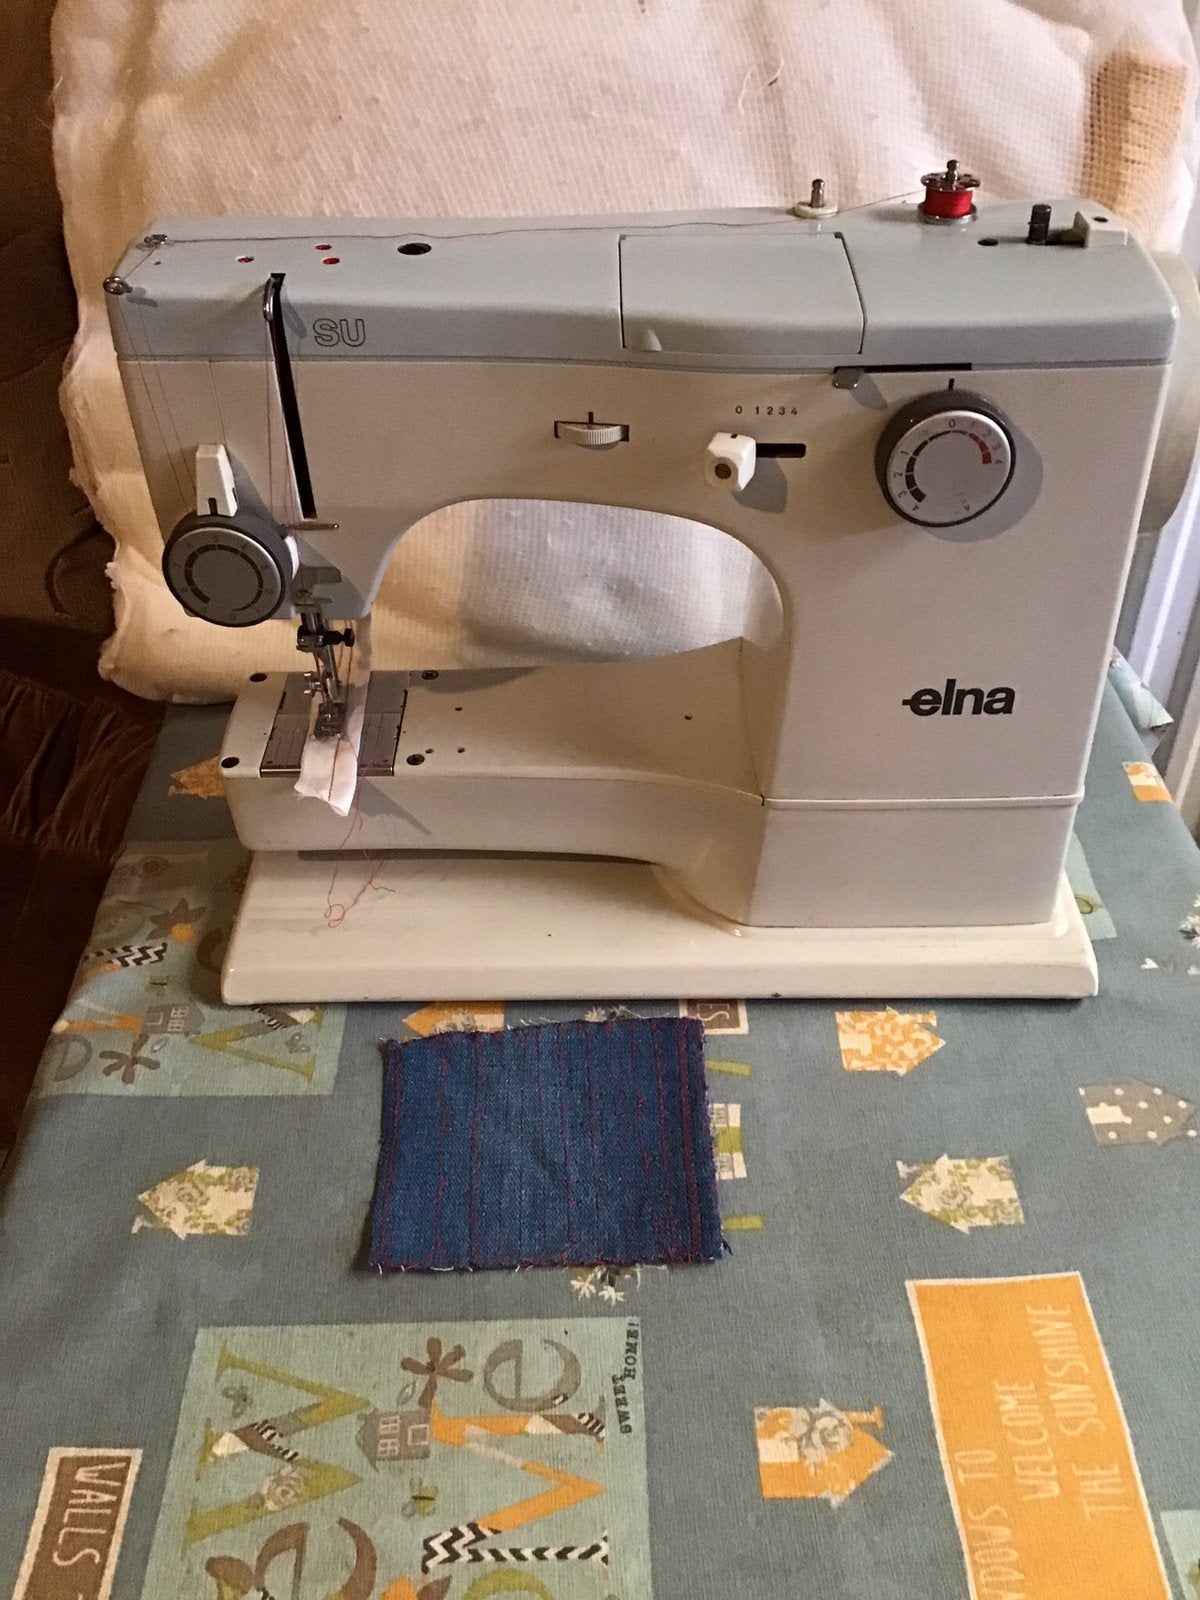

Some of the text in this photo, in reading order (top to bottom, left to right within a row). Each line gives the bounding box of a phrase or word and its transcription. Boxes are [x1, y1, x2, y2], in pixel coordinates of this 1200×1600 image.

[312, 318, 366, 347] SU
[735, 405, 798, 415] 0 1 2 3 4
[902, 679, 1016, 717] elna
[624, 1322, 639, 1380] HOME!
[612, 1374, 632, 1434] SWEET
[1025, 1303, 1131, 1521] THE SUNSHINE
[954, 1449, 998, 1486] TO
[994, 1380, 1061, 1501] WELCOME
[53, 1462, 126, 1566] WALLS
